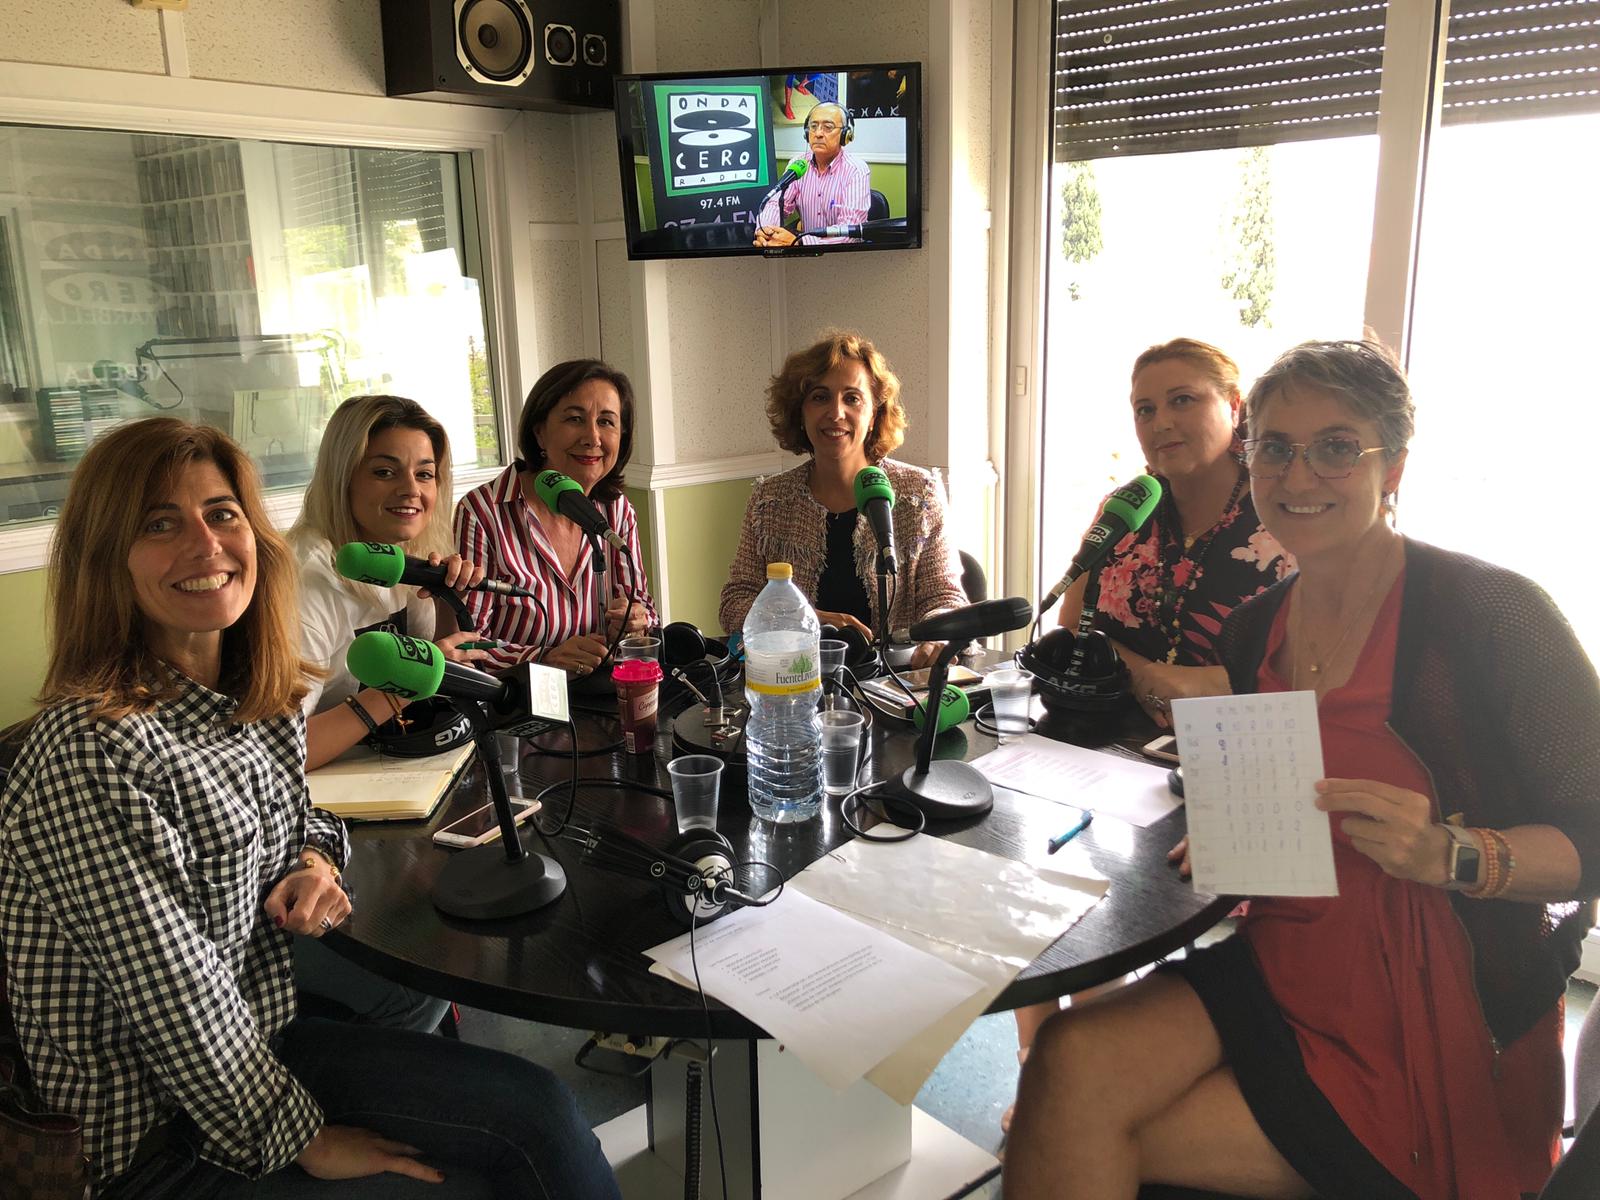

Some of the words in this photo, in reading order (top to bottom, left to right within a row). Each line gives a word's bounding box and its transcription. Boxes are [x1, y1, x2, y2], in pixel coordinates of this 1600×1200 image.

[678, 97, 748, 110] ONDA
[675, 149, 750, 170] CERO
[679, 172, 753, 185] RADIO
[700, 198, 723, 209] 97.4
[726, 195, 740, 206] FM
